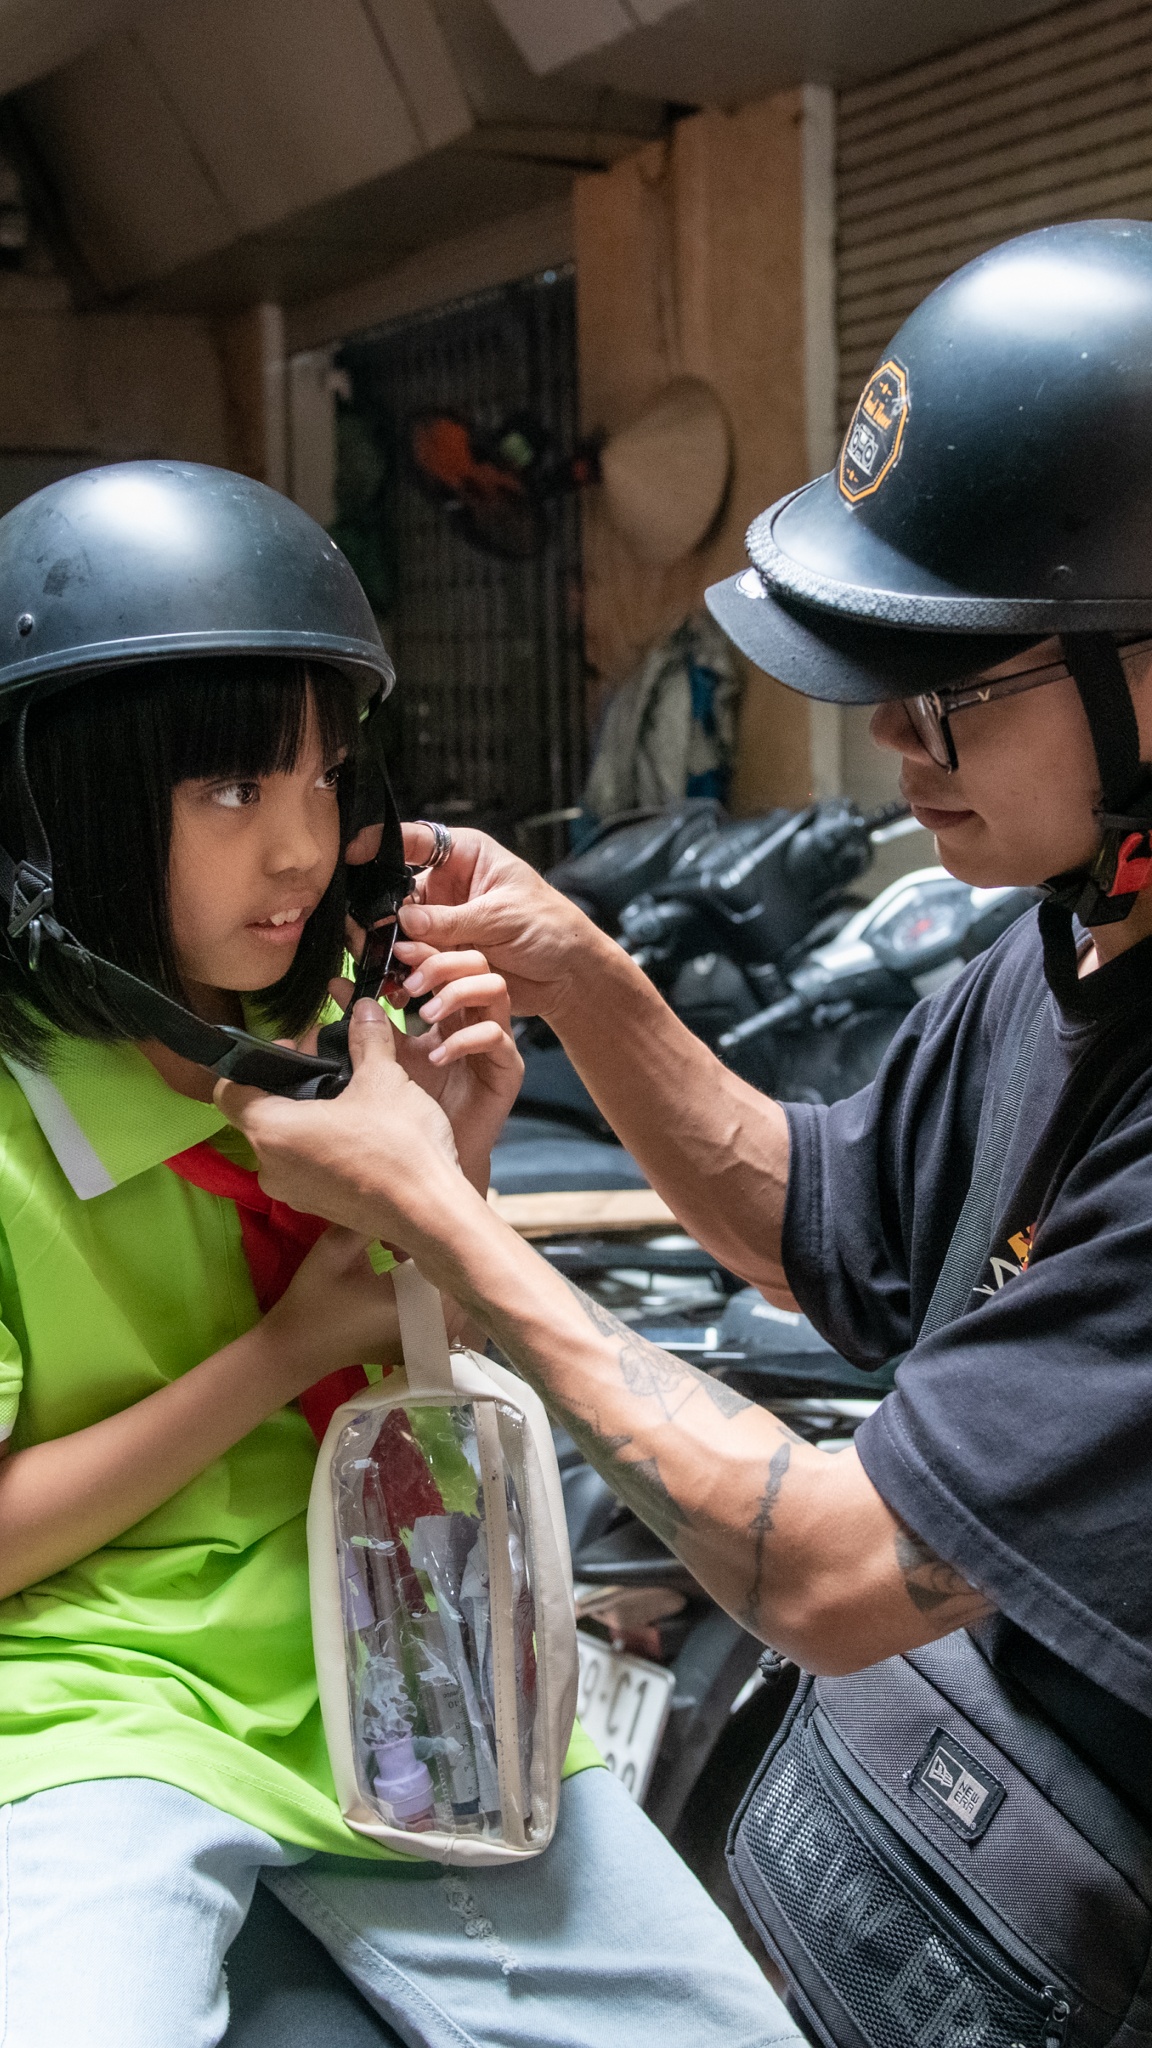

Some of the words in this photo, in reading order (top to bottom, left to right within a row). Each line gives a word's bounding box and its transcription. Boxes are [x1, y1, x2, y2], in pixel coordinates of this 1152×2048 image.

[576, 1655, 649, 1746] 9-C1
[953, 1791, 975, 1814] ERA
[959, 1780, 980, 1803] NEW
[751, 1758, 904, 1951] NEW
[882, 1934, 1025, 2048] ER
